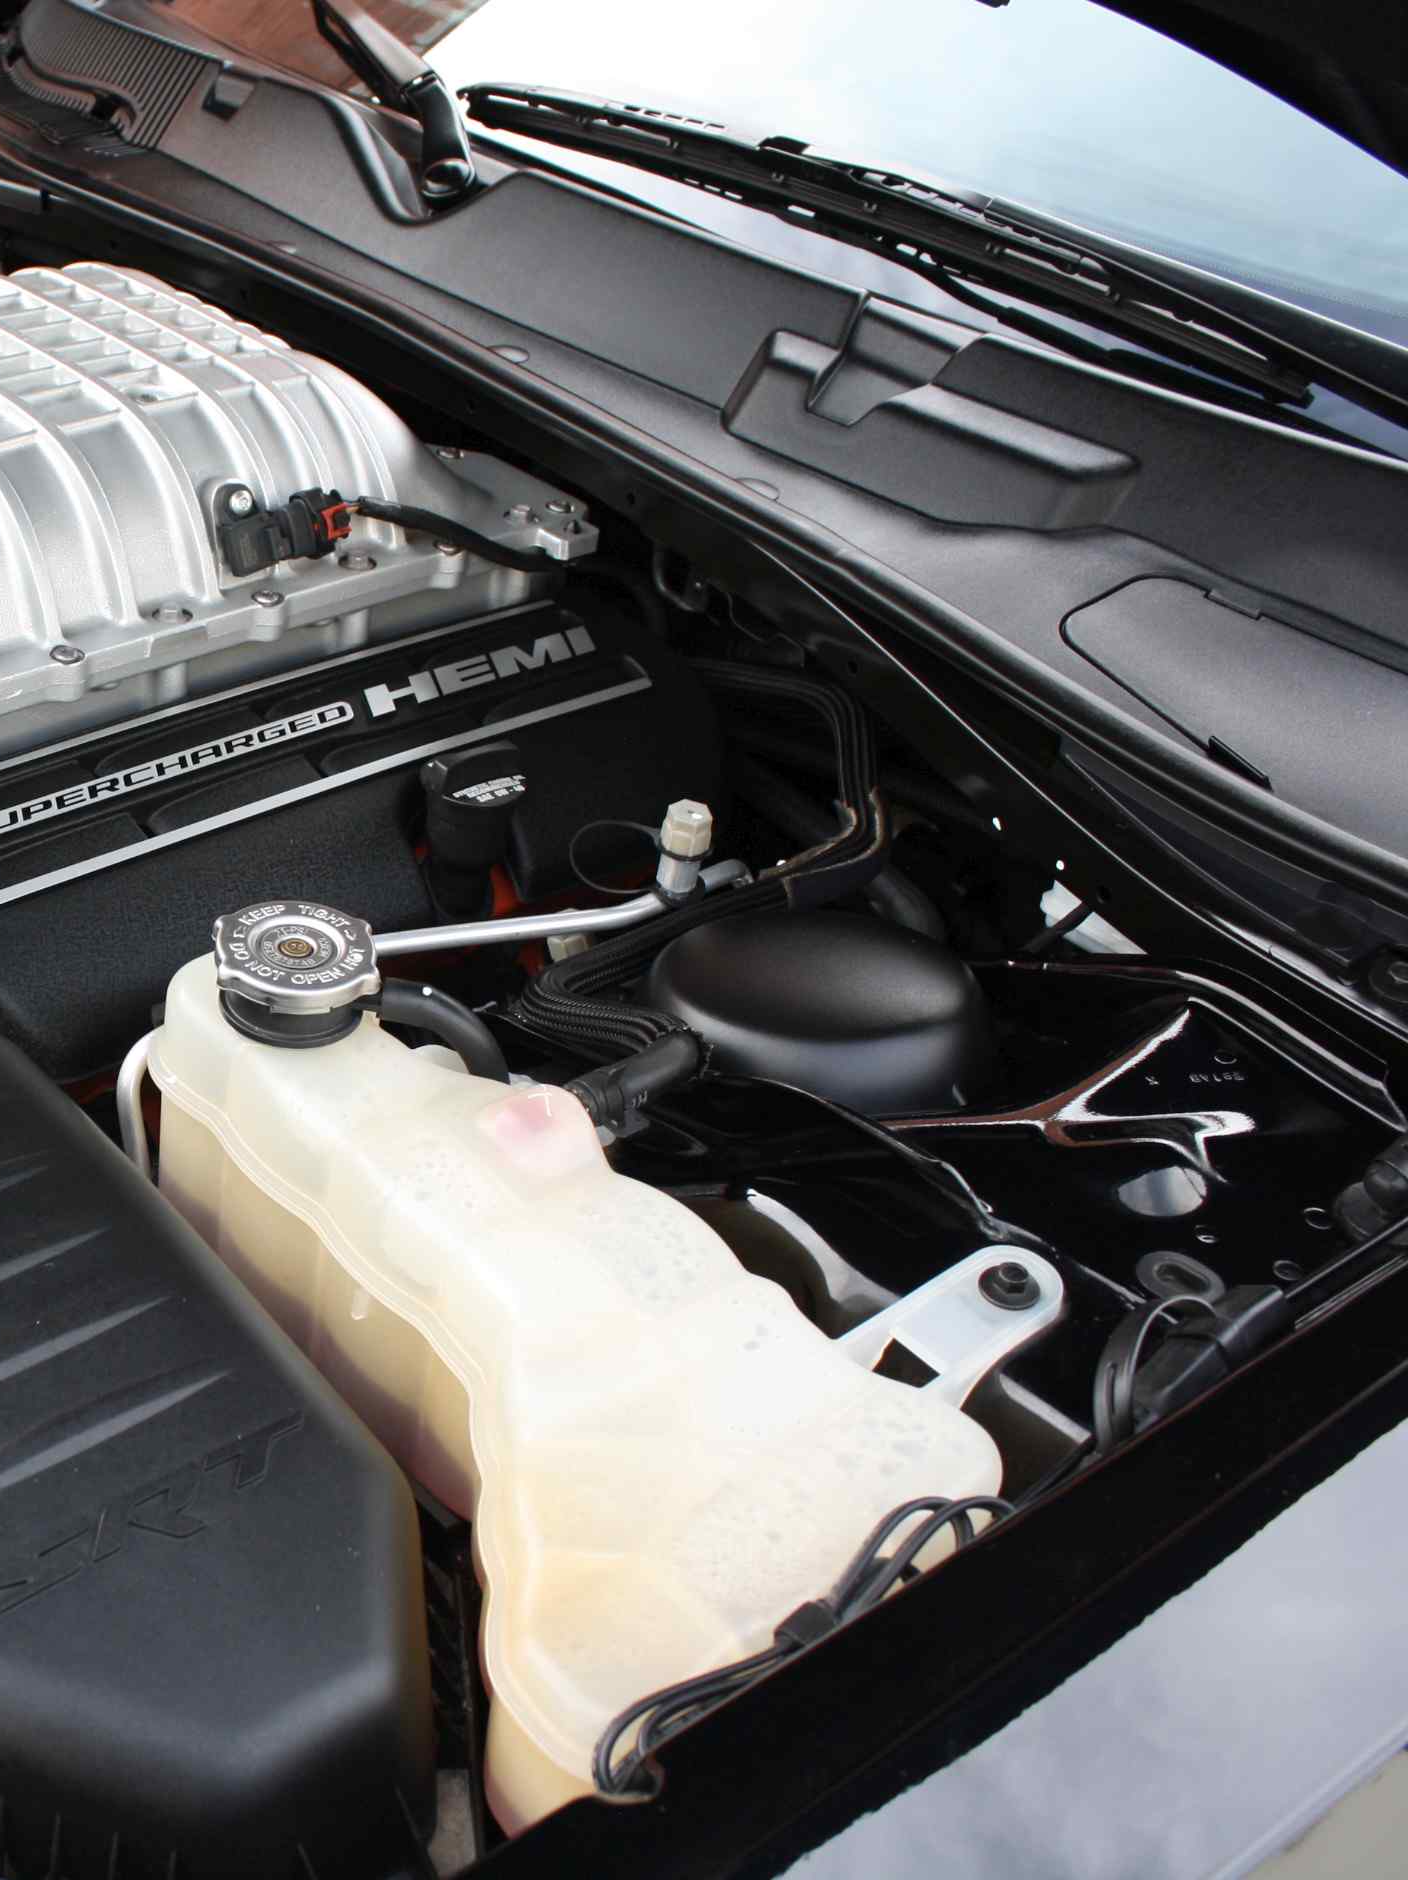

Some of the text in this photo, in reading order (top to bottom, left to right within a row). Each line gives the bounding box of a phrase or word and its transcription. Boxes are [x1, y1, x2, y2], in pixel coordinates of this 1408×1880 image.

[364, 625, 596, 717] HEMI
[239, 905, 351, 927] KEEP TIGHT
[229, 943, 249, 961] DO
[245, 960, 286, 981] NOT
[291, 967, 345, 985] OPEN
[340, 947, 365, 972] HOT
